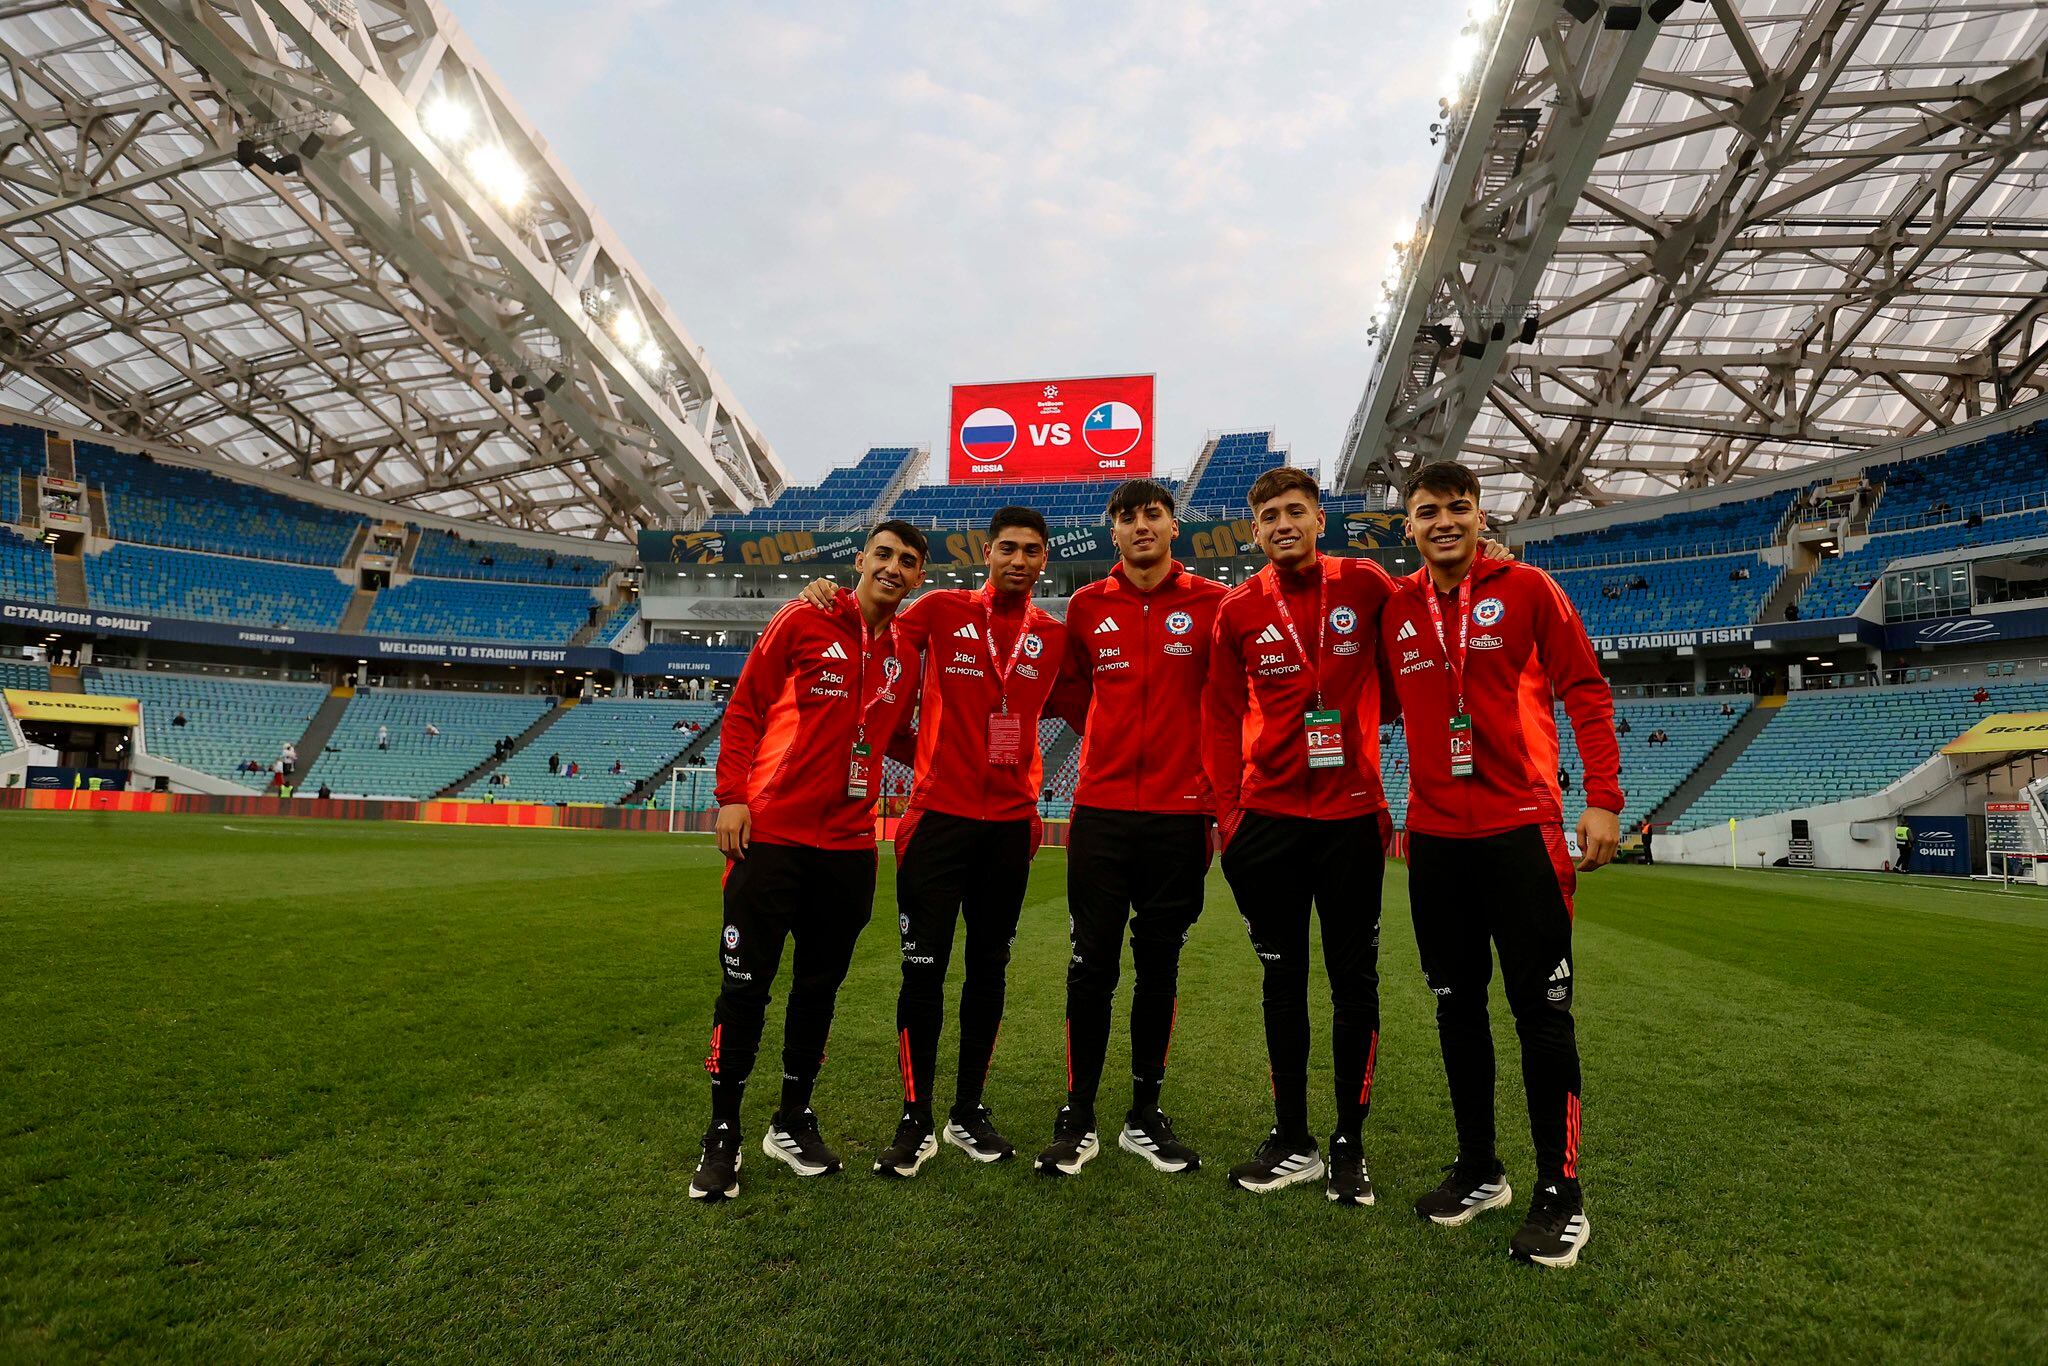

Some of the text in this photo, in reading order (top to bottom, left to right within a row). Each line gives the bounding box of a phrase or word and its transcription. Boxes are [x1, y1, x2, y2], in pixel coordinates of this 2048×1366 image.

[1029, 423, 1072, 446] VS
[972, 464, 1003, 473] RUSSIA
[1098, 460, 1126, 468] CHILE
[1048, 527, 1092, 549] TBALL
[783, 536, 853, 562] ФУТБОЛЬНЫЙ
[831, 546, 859, 559] КЛУБ
[1060, 540, 1098, 559] CLUB
[3, 605, 151, 632] СТАДИОН ФИШТ
[239, 632, 296, 645] FISHT.INFO
[1287, 623, 1303, 653] BetBoom
[1472, 639, 1500, 648] CRISTAL
[1591, 628, 1754, 652] TO STADIUM FISHT
[379, 641, 567, 661] WELCOME TO STADIUM FISHT
[1107, 647, 1120, 656] Bci
[1335, 645, 1357, 653] CRISTAL
[962, 653, 976, 663] Bci
[1270, 653, 1284, 664] Bci
[668, 662, 710, 670] FISHT.INFO
[945, 666, 984, 677] MG MOTOR
[1105, 661, 1130, 671] MOTOR
[1270, 664, 1301, 674] MOTOR
[1400, 659, 1435, 675] MG MOTOR
[830, 673, 844, 683] Bci
[811, 686, 823, 696] MG
[28, 700, 121, 711] BetBoom
[1920, 848, 1956, 856] ФИШТ
